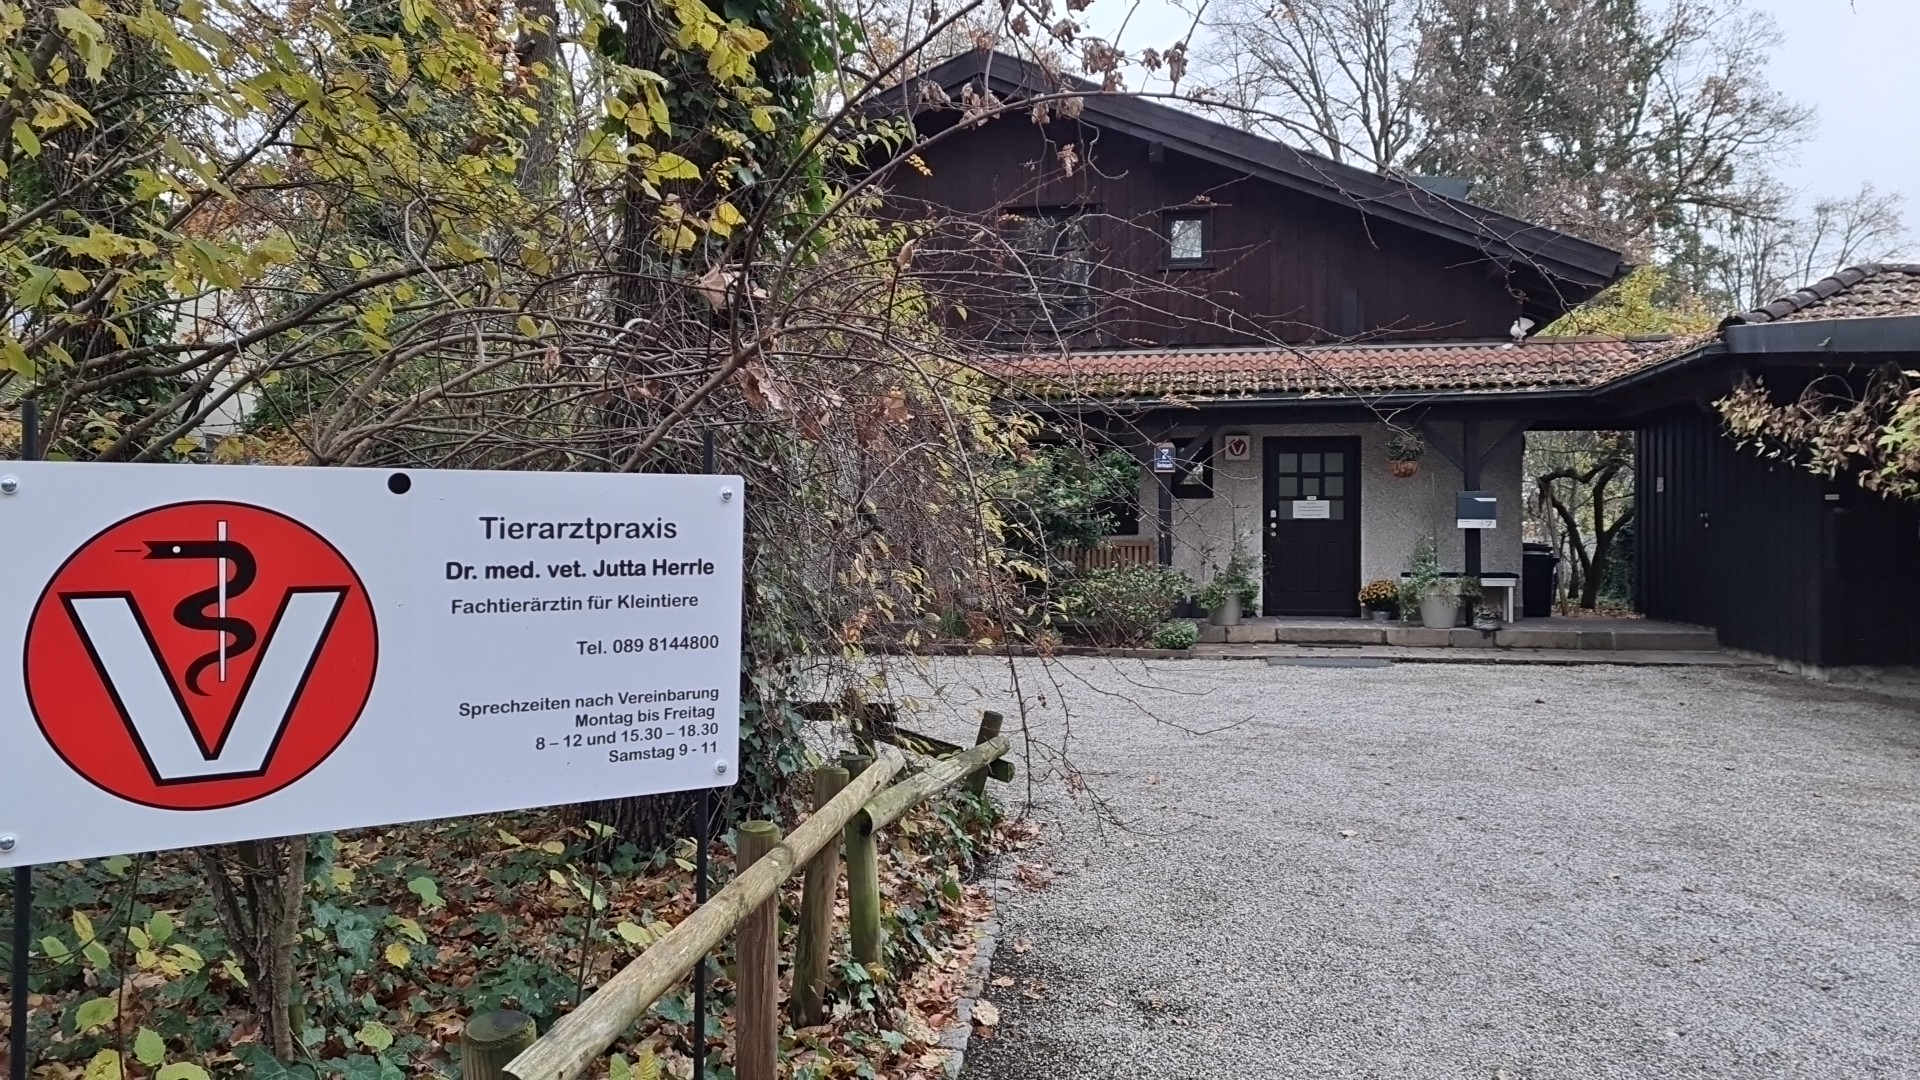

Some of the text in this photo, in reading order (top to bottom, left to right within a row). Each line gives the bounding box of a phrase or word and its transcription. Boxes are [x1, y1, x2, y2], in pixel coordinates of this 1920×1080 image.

[478, 516, 678, 545] Tierarztpraxis
[445, 557, 716, 581] Dr. med. vet. Jutta Herrle
[451, 593, 699, 615] Fachtierärztin für Kleintiere
[575, 634, 720, 656] Tel. 089 8144800
[458, 687, 720, 720] Sprechzeiten nach Vereinbarung
[575, 706, 715, 729] Montag bis Freitag
[535, 737, 546, 751] 8
[563, 733, 583, 749] 12
[586, 730, 617, 747] und
[620, 726, 663, 744] 15.30
[679, 722, 719, 739] 18.30
[608, 746, 676, 764] Samstag
[678, 743, 688, 757] 9
[701, 740, 718, 755] 11
